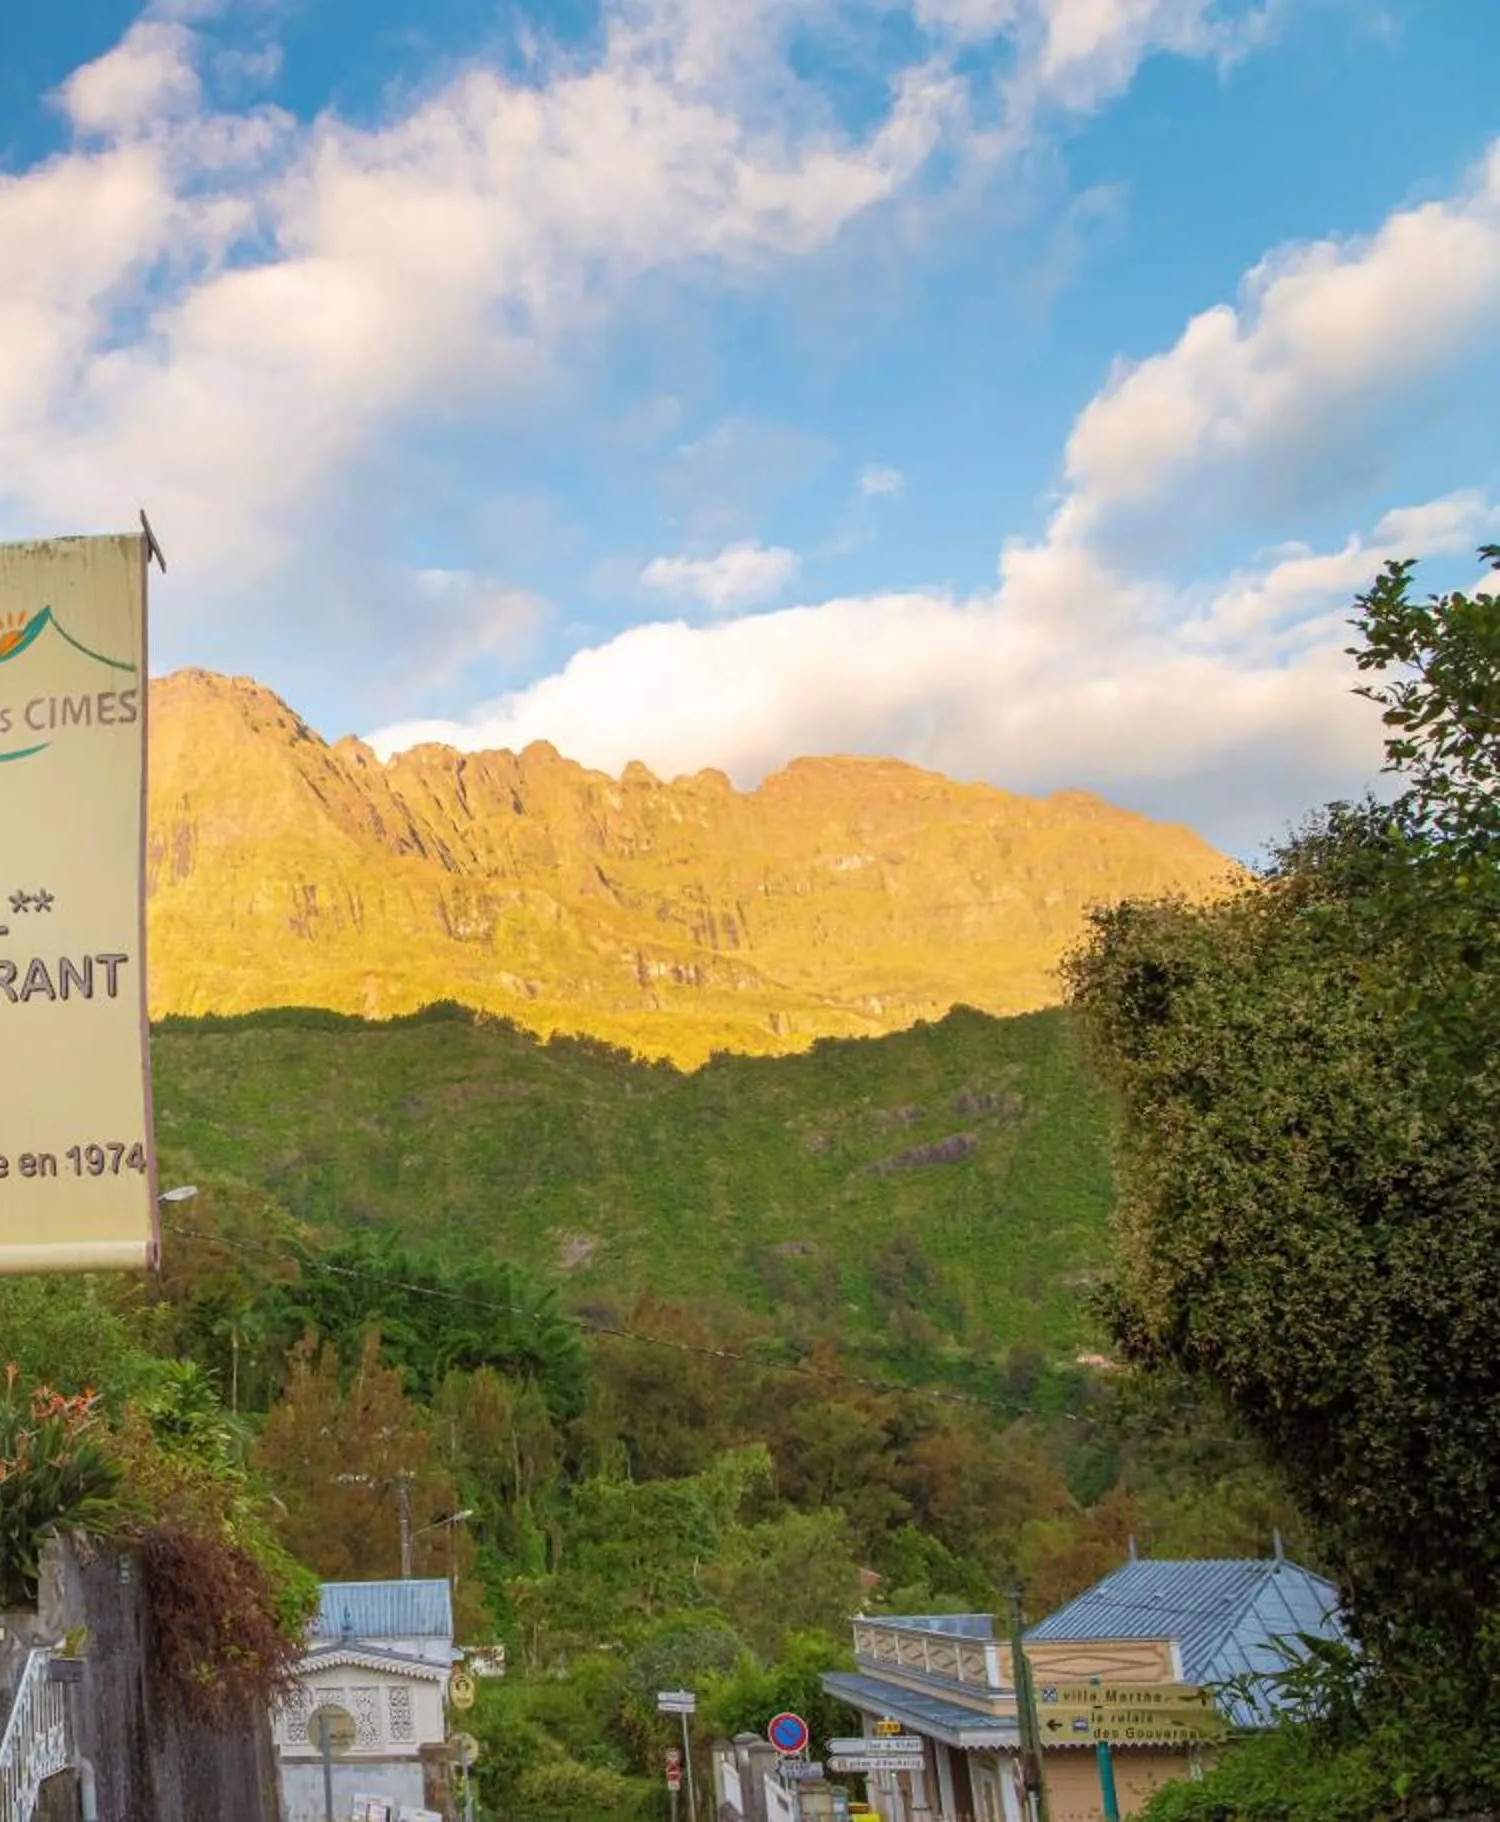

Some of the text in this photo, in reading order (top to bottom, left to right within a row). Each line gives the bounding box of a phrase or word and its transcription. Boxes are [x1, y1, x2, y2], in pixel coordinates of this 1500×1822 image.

[24, 688, 137, 731] CIMES
[18, 1153, 57, 1177] en
[66, 1142, 148, 1176] 1974
[1105, 1690, 1163, 1703] Marthe
[1093, 1727, 1198, 1740] des Gouverne
